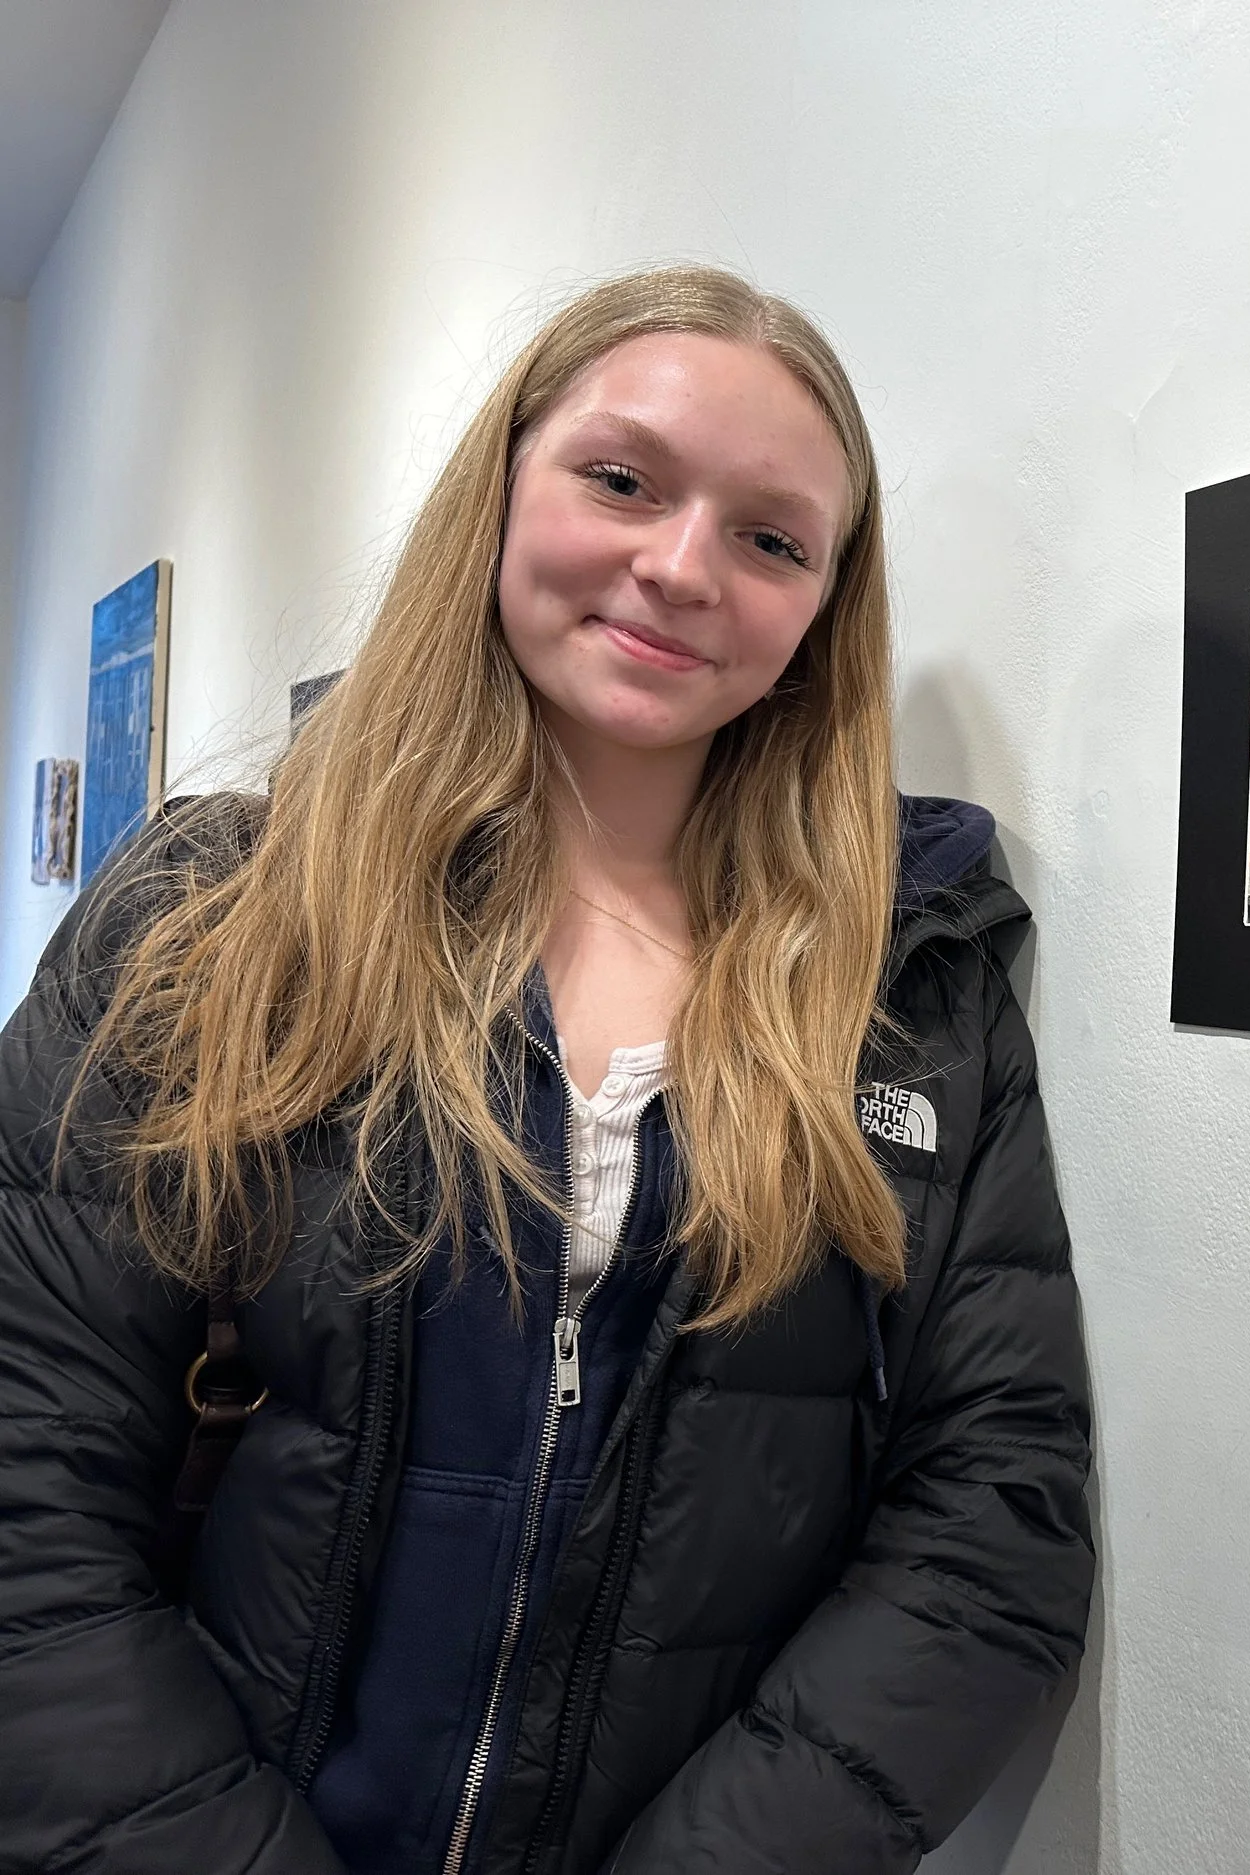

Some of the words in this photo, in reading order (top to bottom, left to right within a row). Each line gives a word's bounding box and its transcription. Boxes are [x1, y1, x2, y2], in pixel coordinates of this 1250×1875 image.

[872, 1081, 910, 1107] THE
[860, 1096, 906, 1126] ORTH
[861, 1114, 904, 1143] FACE
